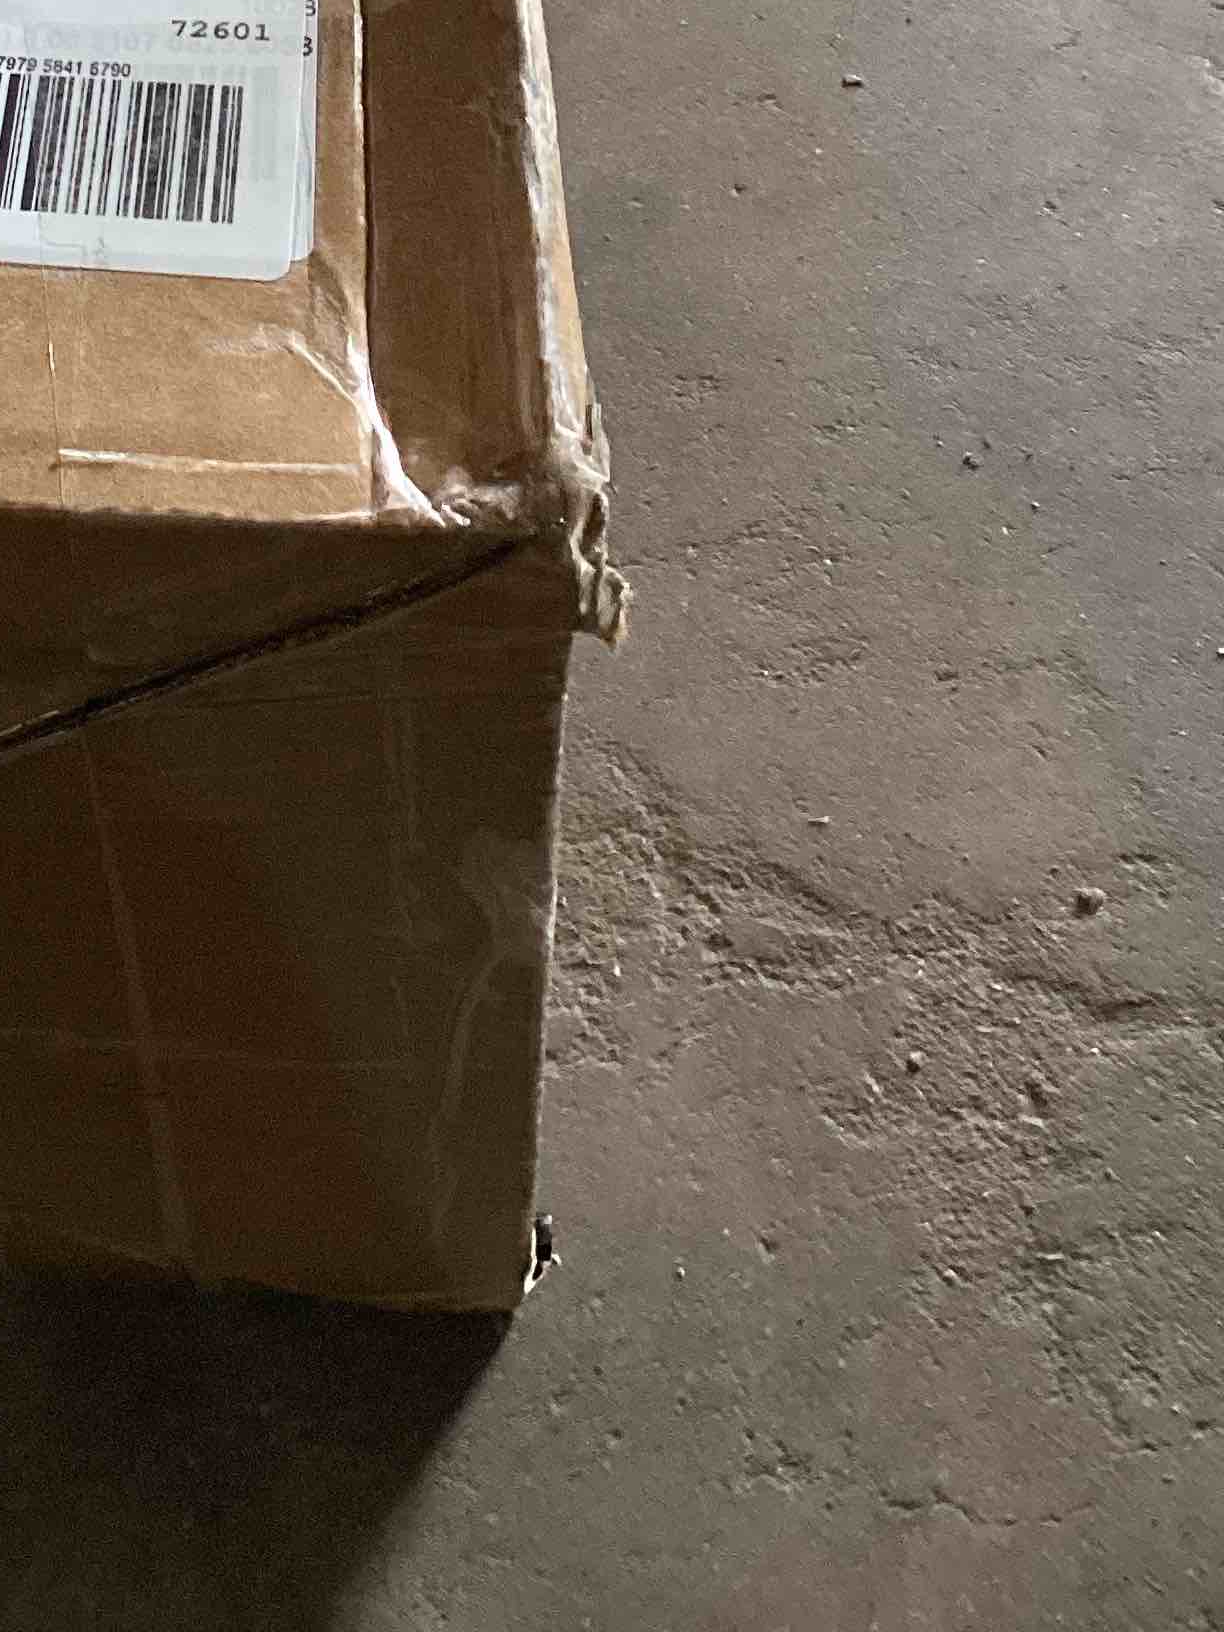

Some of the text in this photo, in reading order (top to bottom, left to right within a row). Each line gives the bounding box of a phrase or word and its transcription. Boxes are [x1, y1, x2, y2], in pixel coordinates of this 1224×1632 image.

[171, 19, 271, 42] 72601
[43, 58, 83, 75] 5841
[89, 60, 131, 77] 6790
